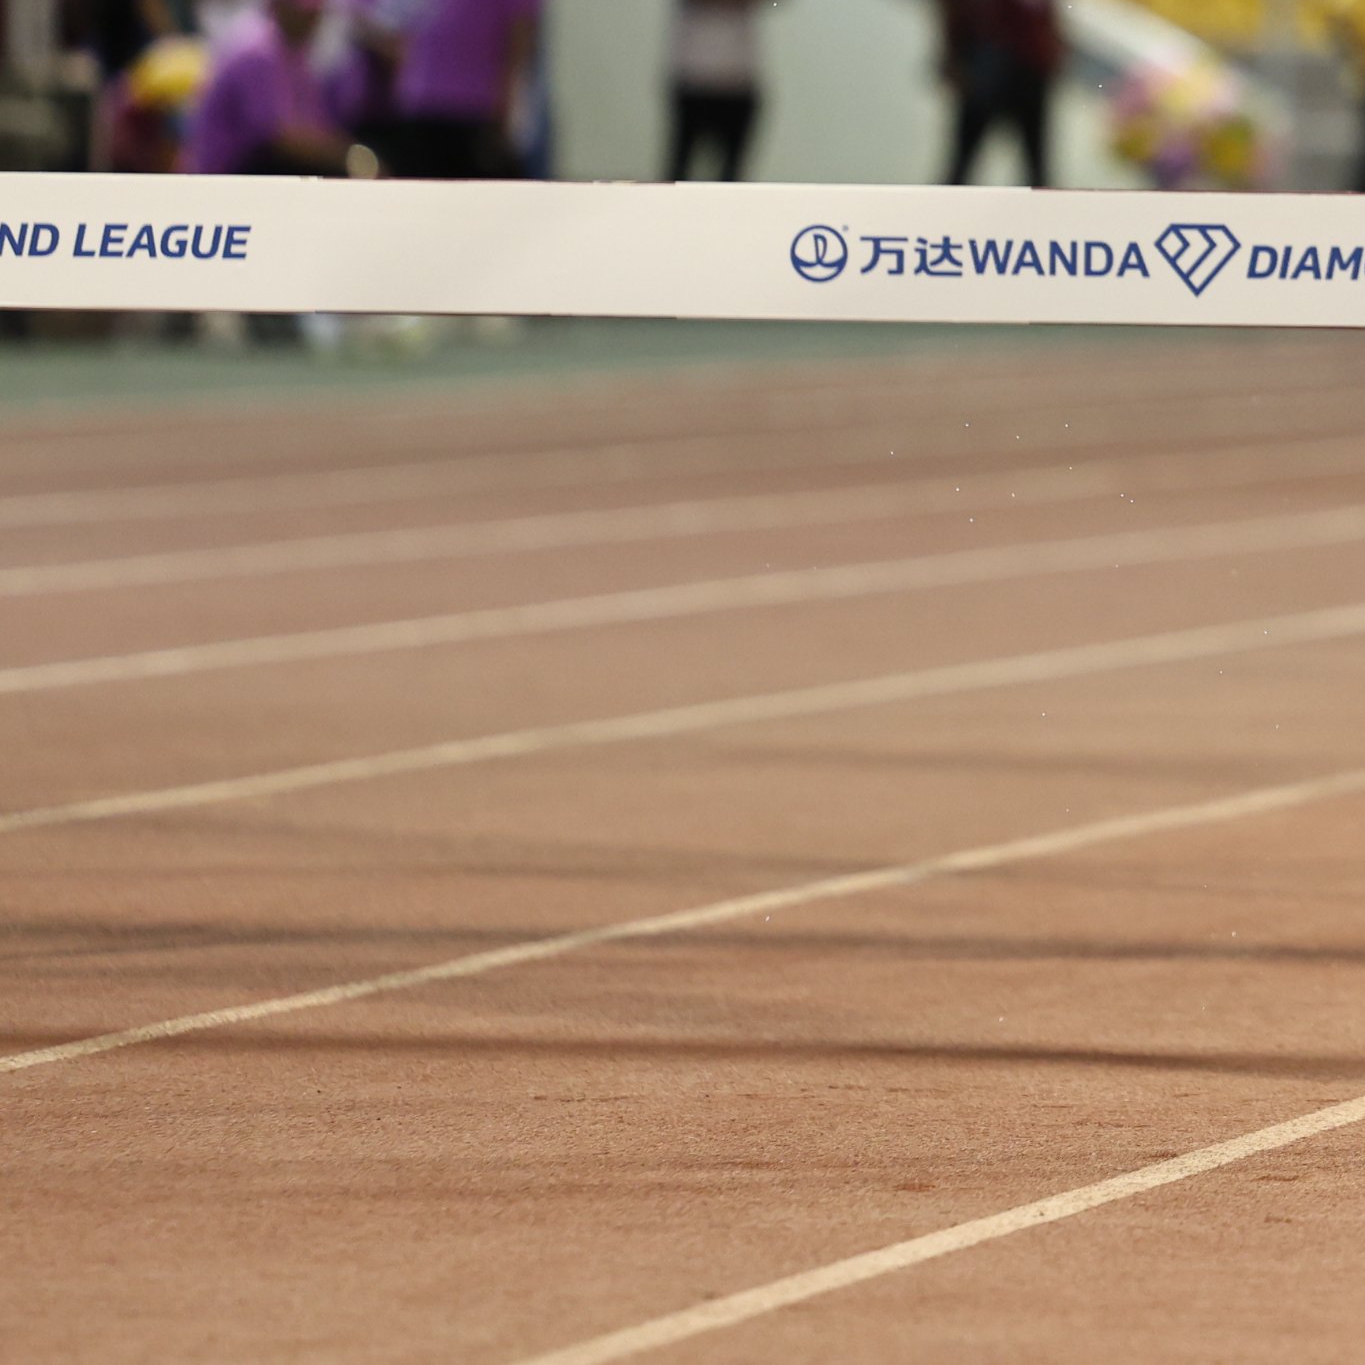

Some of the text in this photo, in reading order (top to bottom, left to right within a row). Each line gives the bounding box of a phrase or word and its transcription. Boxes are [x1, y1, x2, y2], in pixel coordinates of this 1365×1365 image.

[73, 223, 252, 259] LEAGUE
[860, 236, 962, 276] 万达
[969, 239, 1150, 279] WANDA
